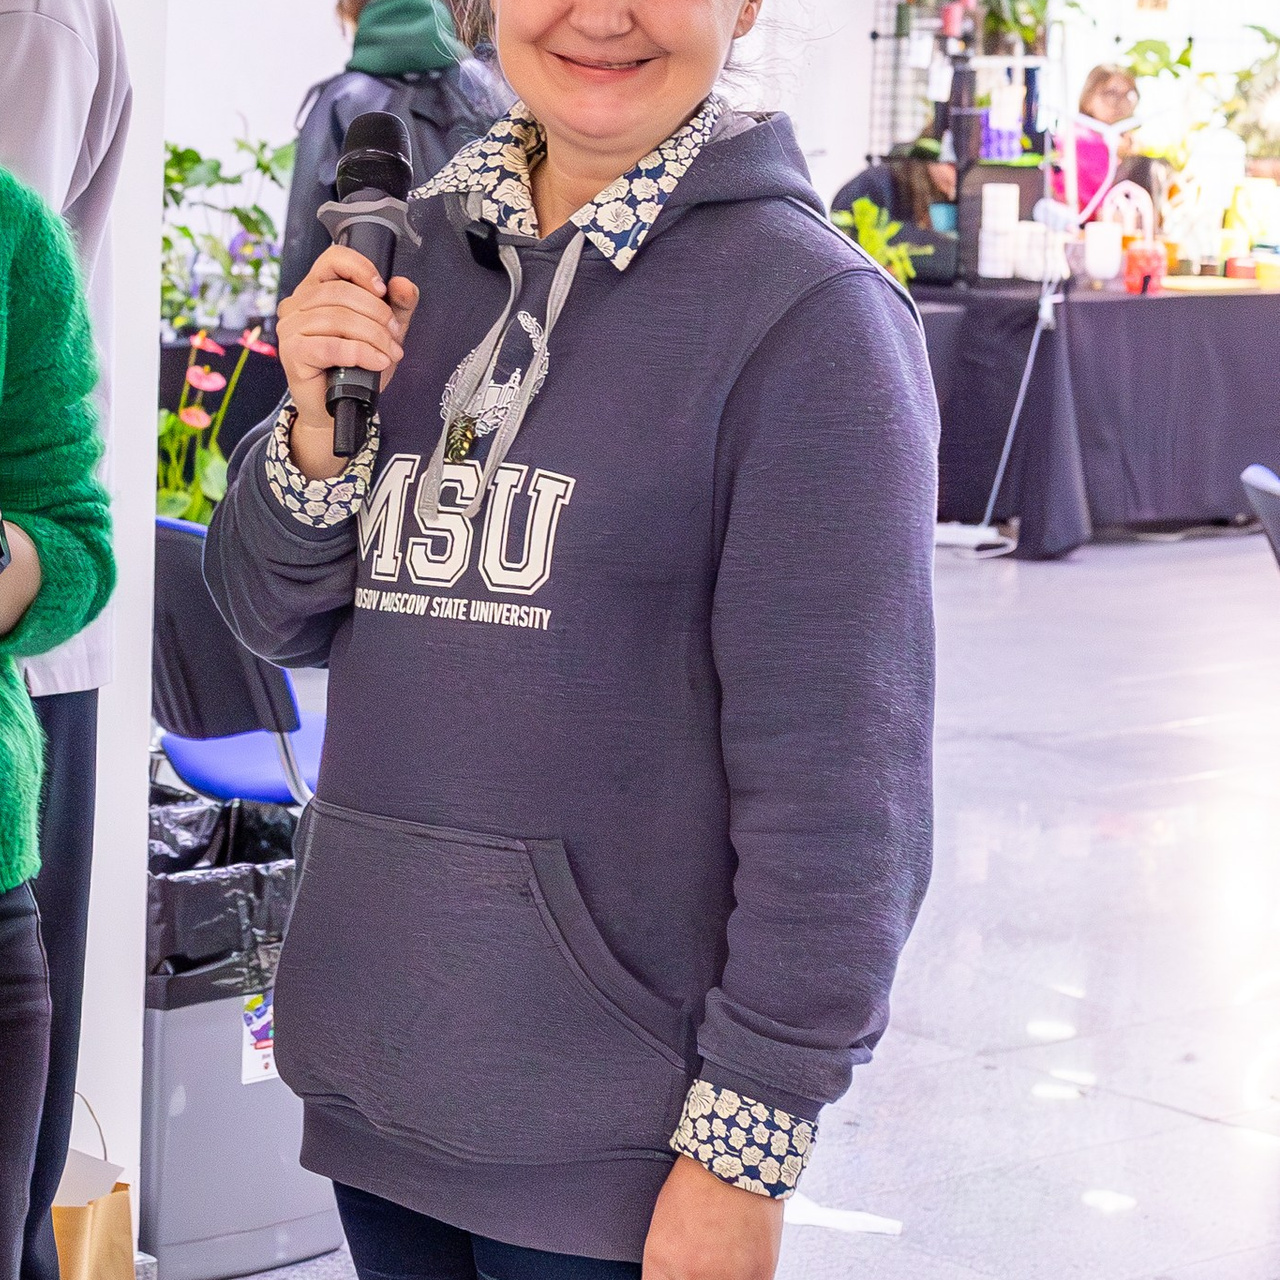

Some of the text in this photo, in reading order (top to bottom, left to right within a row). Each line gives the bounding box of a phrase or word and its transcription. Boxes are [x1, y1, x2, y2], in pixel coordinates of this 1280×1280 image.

[356, 453, 576, 595] MSU
[379, 591, 430, 616] MOSCOW
[430, 596, 469, 621] STATE
[469, 599, 552, 631] UNIVERSITY
